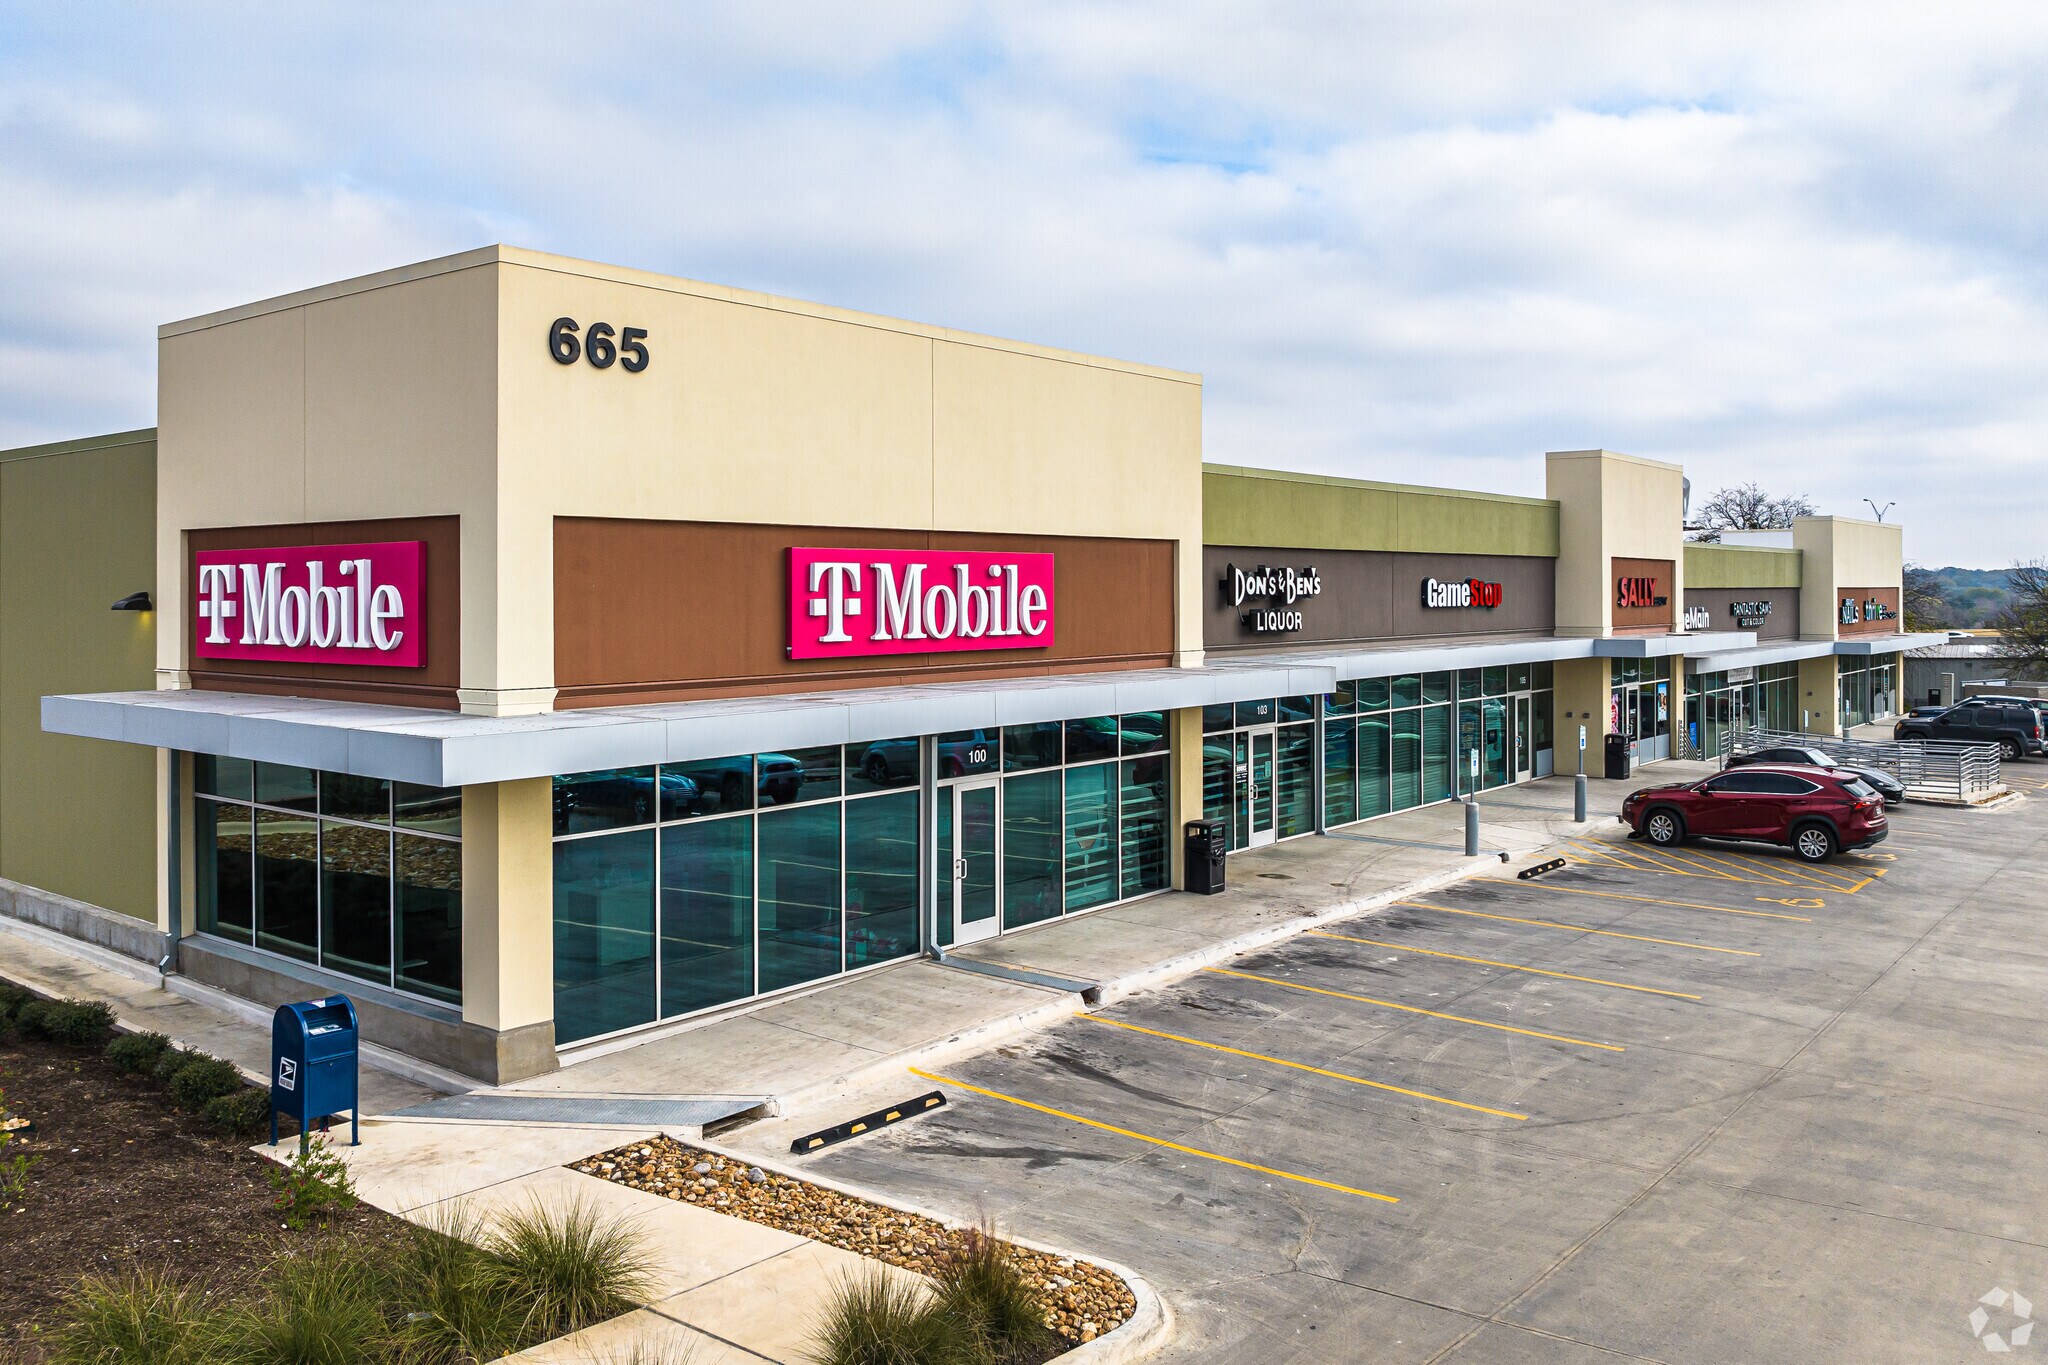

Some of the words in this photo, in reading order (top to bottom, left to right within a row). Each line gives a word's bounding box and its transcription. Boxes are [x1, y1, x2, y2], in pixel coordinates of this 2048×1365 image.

[549, 317, 649, 373] 665
[1427, 577, 1503, 609] GameStop
[1621, 577, 1657, 607] SALLY
[1733, 602, 1758, 616] FANTASTIC
[1842, 605, 1859, 624] NAILS
[1257, 611, 1303, 631] LIQUOR
[1256, 704, 1268, 716] 103
[968, 749, 987, 764] 100
